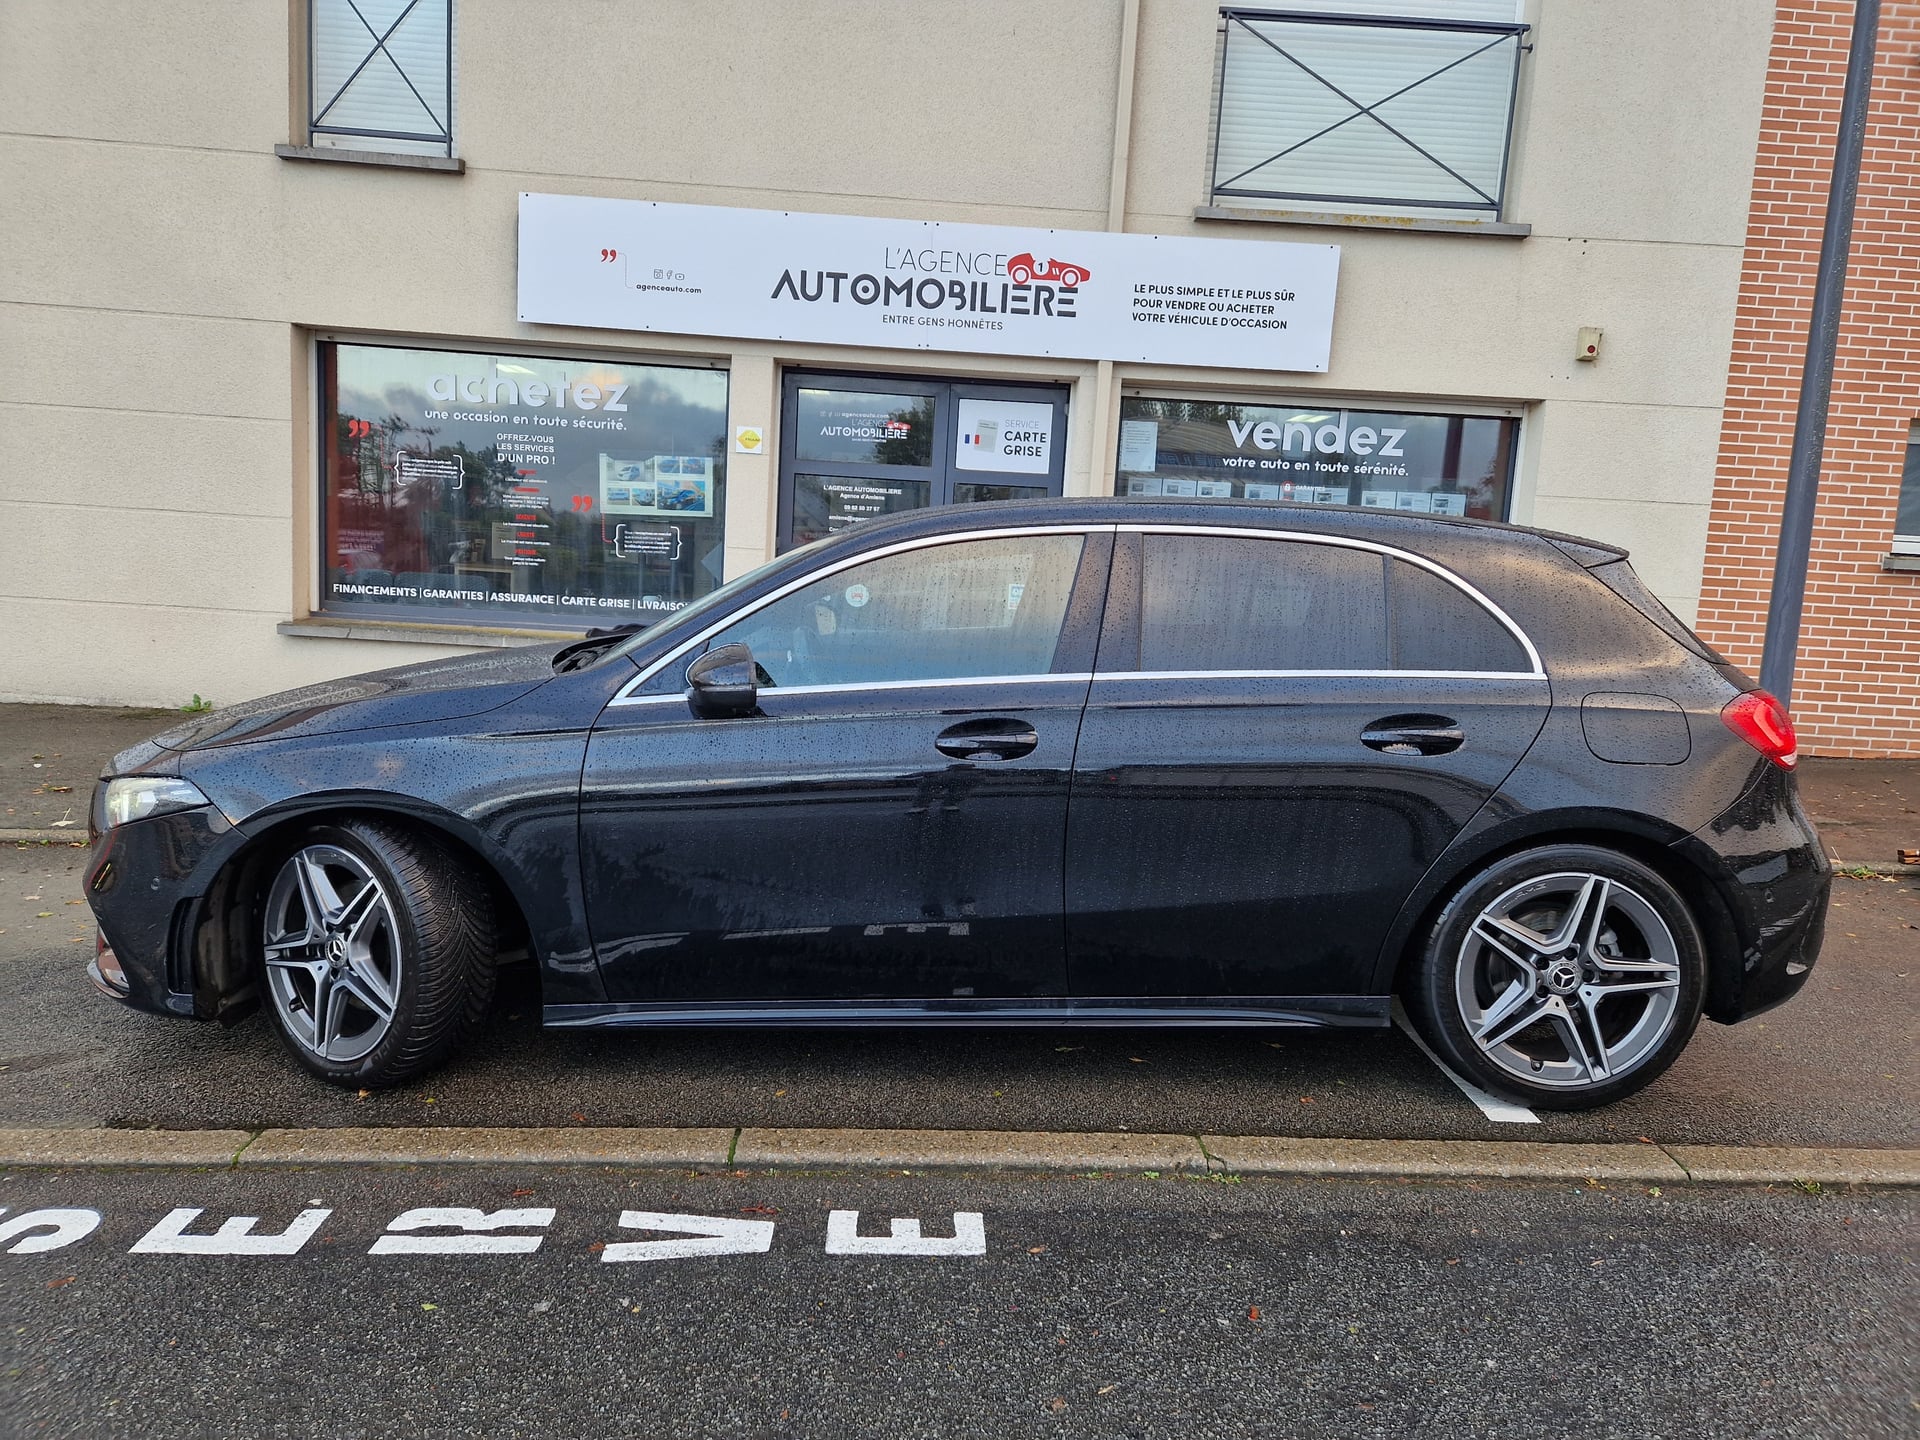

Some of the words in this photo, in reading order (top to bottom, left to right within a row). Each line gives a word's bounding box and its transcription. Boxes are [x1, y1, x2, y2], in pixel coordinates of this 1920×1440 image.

[884, 247, 1008, 277] L'AGENCE
[636, 283, 702, 294] agenceauto.com
[1134, 284, 1146, 294] LE
[1148, 285, 1174, 295] PLUS
[1176, 286, 1215, 298] SIMPLE
[1217, 288, 1230, 298] ET
[1231, 289, 1244, 299] LE
[1246, 290, 1272, 301] PLUS
[1274, 288, 1296, 302] SÛR
[1133, 298, 1163, 309] POUR
[1165, 300, 1206, 311] VENDRE
[1208, 302, 1225, 312] OU
[1226, 303, 1275, 315] ACHETER
[882, 314, 915, 326] ENTRE
[917, 316, 945, 328] GENS
[947, 317, 1003, 331] HONNÊTES
[1132, 312, 1166, 323] VOTRE
[1168, 312, 1218, 326] VÉHICULE
[1220, 317, 1288, 330] D'OCCASION
[425, 357, 631, 412] achetez
[424, 409, 449, 420] une
[453, 410, 508, 424] occasion
[513, 415, 529, 425] en
[533, 416, 568, 428] toute
[572, 416, 627, 431] sécurité.
[841, 411, 889, 419] agenceauto.com
[851, 419, 887, 428] L'AGENCE
[1005, 419, 1040, 430] SERVICE
[496, 433, 554, 444] OFFREZ-VOUS
[1004, 430, 1047, 443] CARTE
[1226, 408, 1407, 457] vendez
[496, 443, 513, 452] LES
[514, 443, 555, 453] SERVICES
[1003, 444, 1043, 457] GRISE
[497, 453, 524, 464] D'UN
[526, 454, 550, 465] PRO
[1222, 457, 1256, 469] votre
[1260, 459, 1290, 470] auto
[1294, 462, 1310, 471] en
[1314, 460, 1350, 473] toute
[1353, 462, 1409, 477] sérénité.
[823, 484, 853, 492] L'AGENCE
[840, 492, 860, 500] Agence
[860, 493, 886, 501] d'Amiens
[333, 583, 417, 597] FINANCEMENTS
[423, 590, 484, 601] GARANTIES
[490, 592, 554, 605] ASSURANCE
[561, 595, 596, 607] CARTE
[598, 597, 630, 609] GRISE
[637, 600, 688, 611] LIVRAISO
